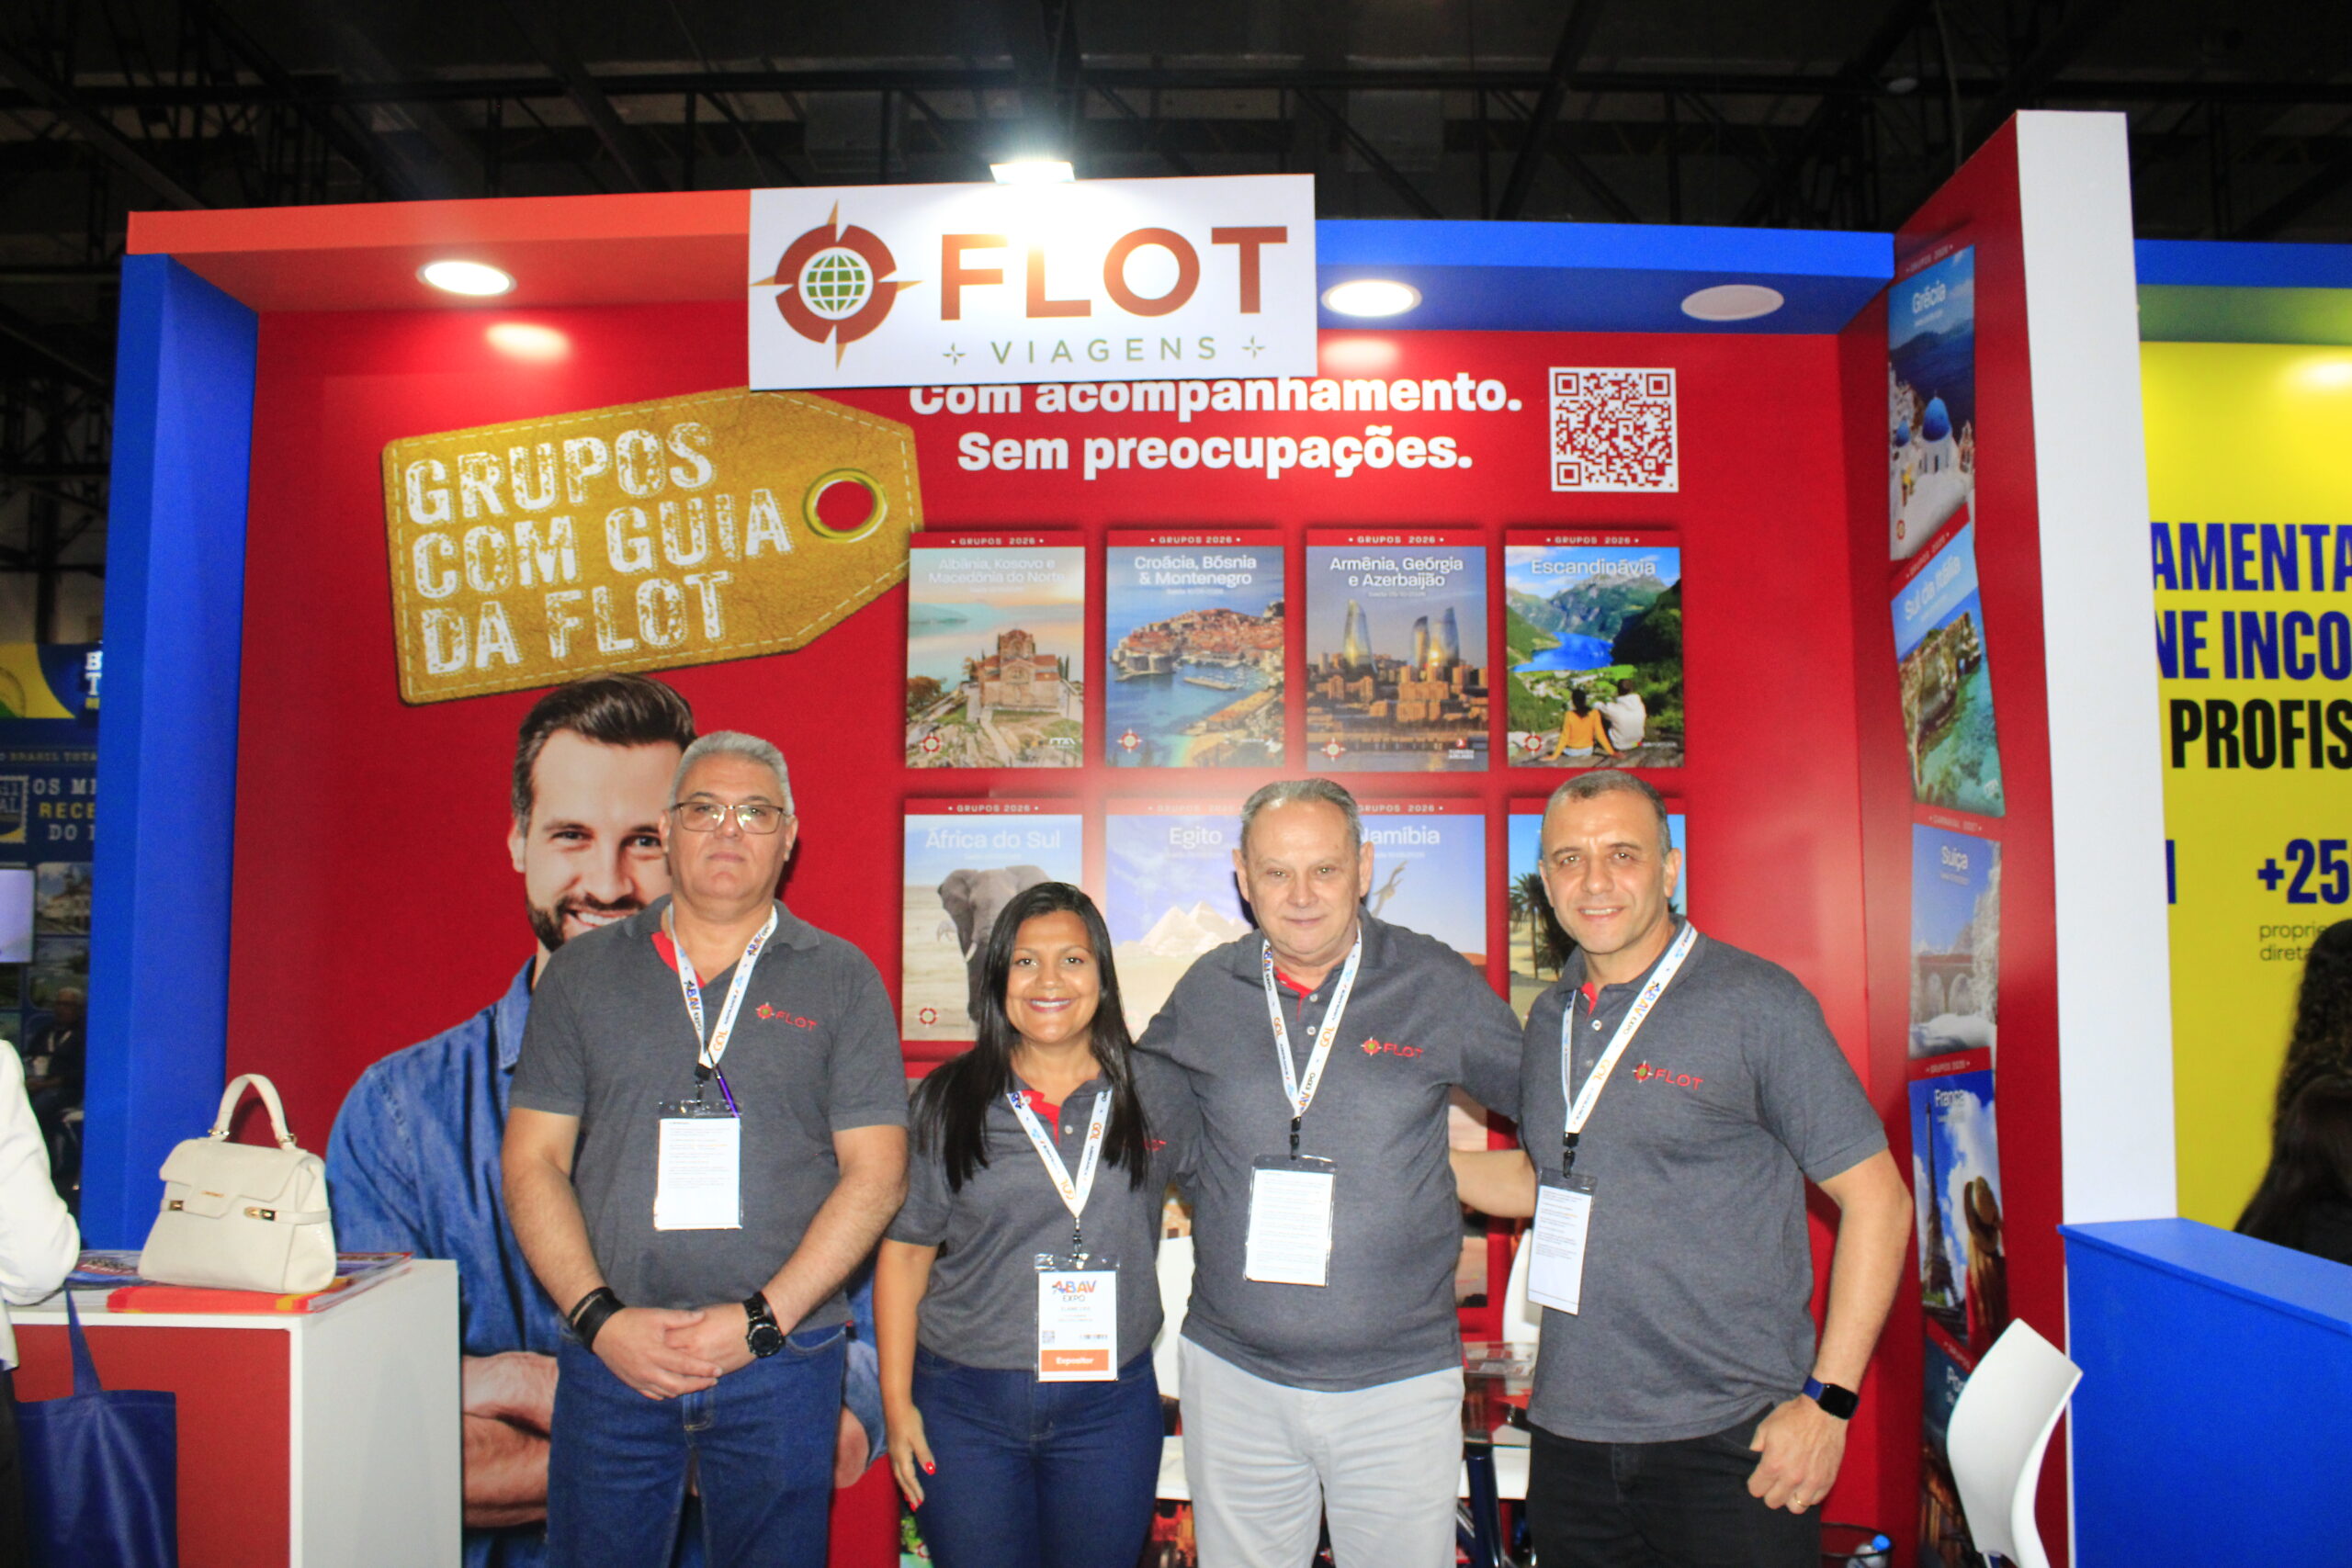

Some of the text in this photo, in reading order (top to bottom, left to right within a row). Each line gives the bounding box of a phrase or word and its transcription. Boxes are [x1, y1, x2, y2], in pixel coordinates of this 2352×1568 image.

[941, 226, 1288, 321] FLOT
[990, 336, 1216, 364] VIAGENS
[909, 372, 1522, 422] Com acompanhamento.
[957, 425, 1472, 480] Sem preocupações.
[405, 422, 717, 525] GRUPOS
[412, 488, 794, 600] COM GUIA
[959, 537, 1002, 546] GRUPOS
[1159, 536, 1202, 544] GRUPOS
[1357, 536, 1401, 544] GRUPOS
[1555, 536, 1598, 544] GRUPOS
[995, 558, 1044, 570] Kosovo
[1046, 559, 1056, 570] e
[1134, 555, 1257, 570] Croácia, Bósnia
[1329, 556, 1464, 574] Armênia, Geórgia
[1531, 558, 1656, 575] Escandinávia
[2150, 522, 2352, 592] AMENTA
[1007, 571, 1023, 582] do
[1027, 571, 1065, 582] Norte
[1139, 571, 1252, 589] & Montenegro
[1348, 572, 1445, 590] e Azerbaijão
[420, 570, 731, 675] DA FLOT
[2221, 610, 2352, 681] INCO
[2169, 698, 2352, 769] PROFIS
[32, 778, 61, 795] OS
[48, 823, 78, 841] DO
[926, 827, 1061, 849] África do Sul
[1170, 826, 1223, 850] Egito
[1940, 845, 1968, 872] Suíça
[775, 1010, 818, 1032] FLOT
[1273, 1017, 1283, 1038] GOL
[712, 1030, 729, 1051] GOL
[1319, 1026, 1335, 1047] GOL
[1383, 1043, 1423, 1058] FLOT
[1655, 1068, 1704, 1090] FLOT
[1089, 1122, 1102, 1140] GOL
[1052, 1280, 1097, 1294] ABAV
[1056, 1356, 1094, 1366] Expositor
